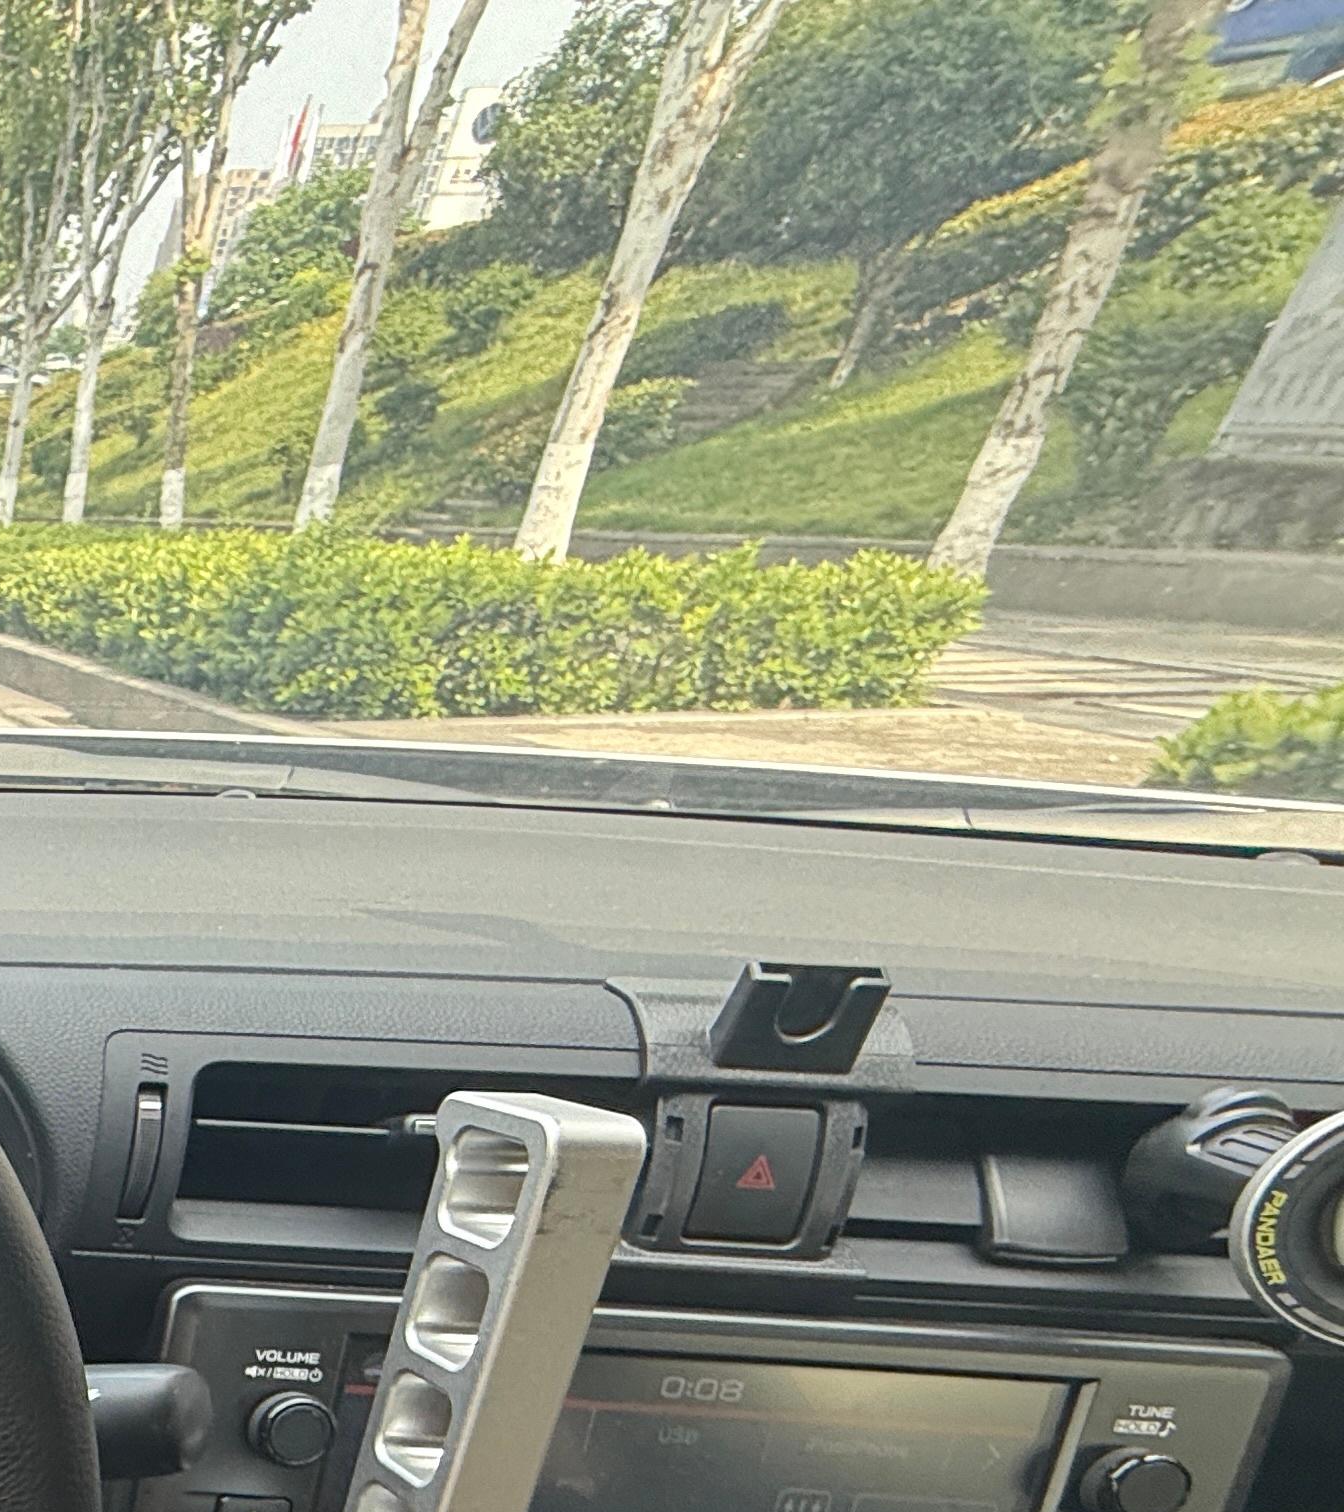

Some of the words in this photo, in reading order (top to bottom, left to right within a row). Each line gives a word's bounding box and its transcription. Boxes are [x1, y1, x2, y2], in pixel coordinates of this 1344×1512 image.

[1255, 1189, 1289, 1285] PANDAER
[255, 1349, 321, 1365] VOLUME
[661, 1375, 745, 1401] 0:08
[1129, 1404, 1175, 1419] TUNE
